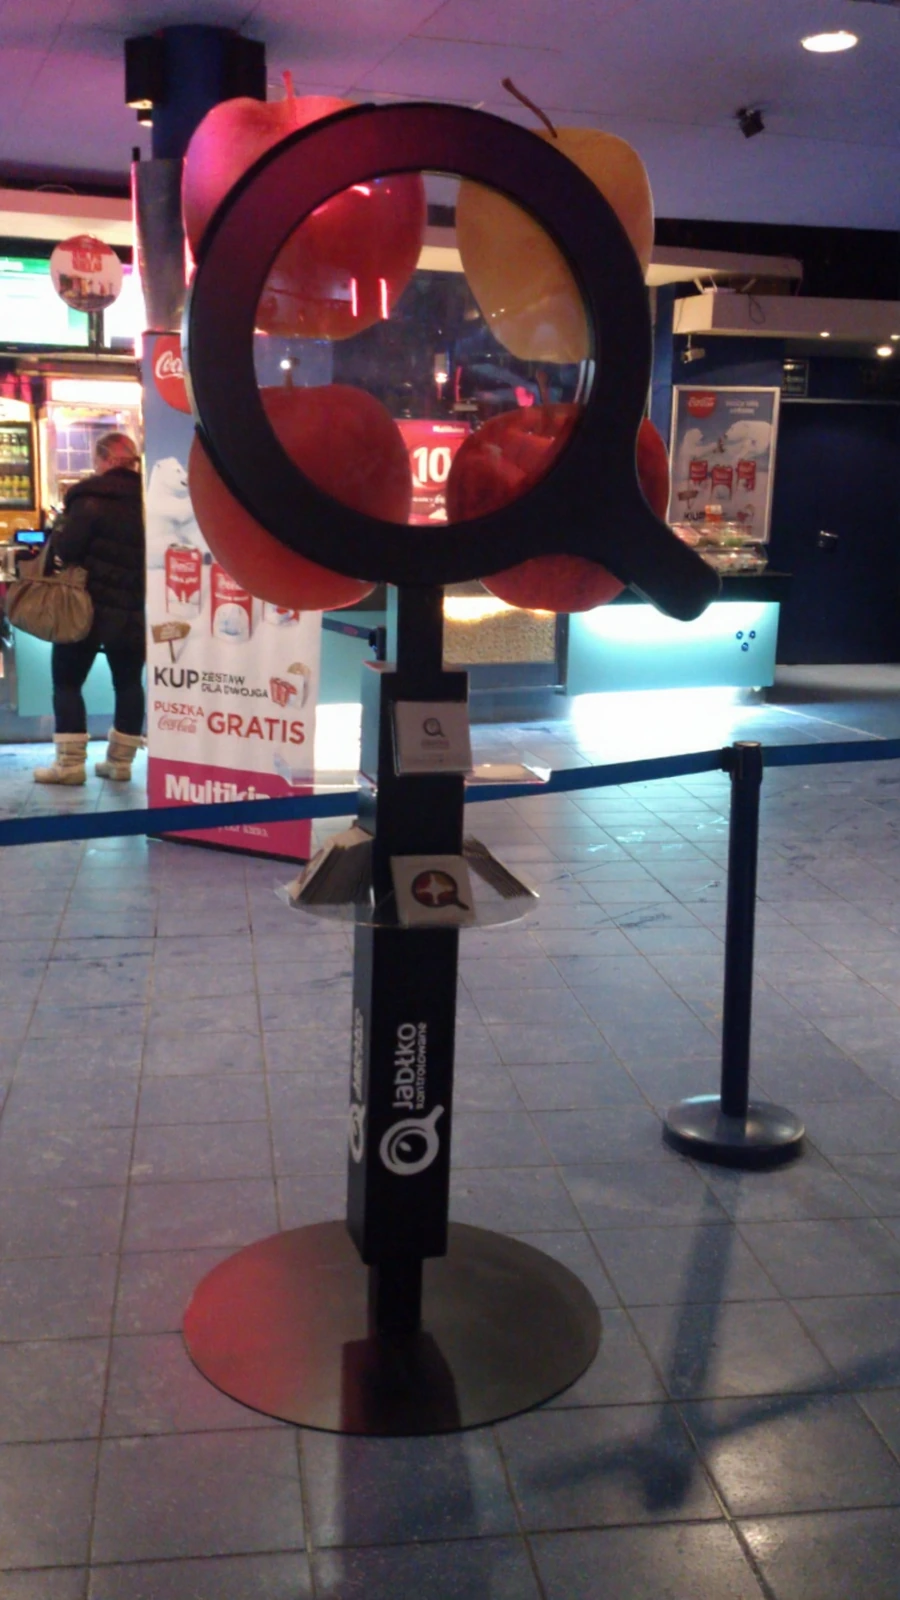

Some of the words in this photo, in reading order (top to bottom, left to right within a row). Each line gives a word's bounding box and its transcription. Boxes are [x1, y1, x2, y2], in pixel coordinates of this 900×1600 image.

[413, 446, 451, 483] 10
[154, 666, 199, 689] KUP
[201, 671, 246, 685] ZESTAW
[201, 683, 222, 694] DLA
[223, 685, 269, 698] DWOJGA
[154, 701, 204, 717] PUSZKA
[207, 711, 305, 745] GRATIS
